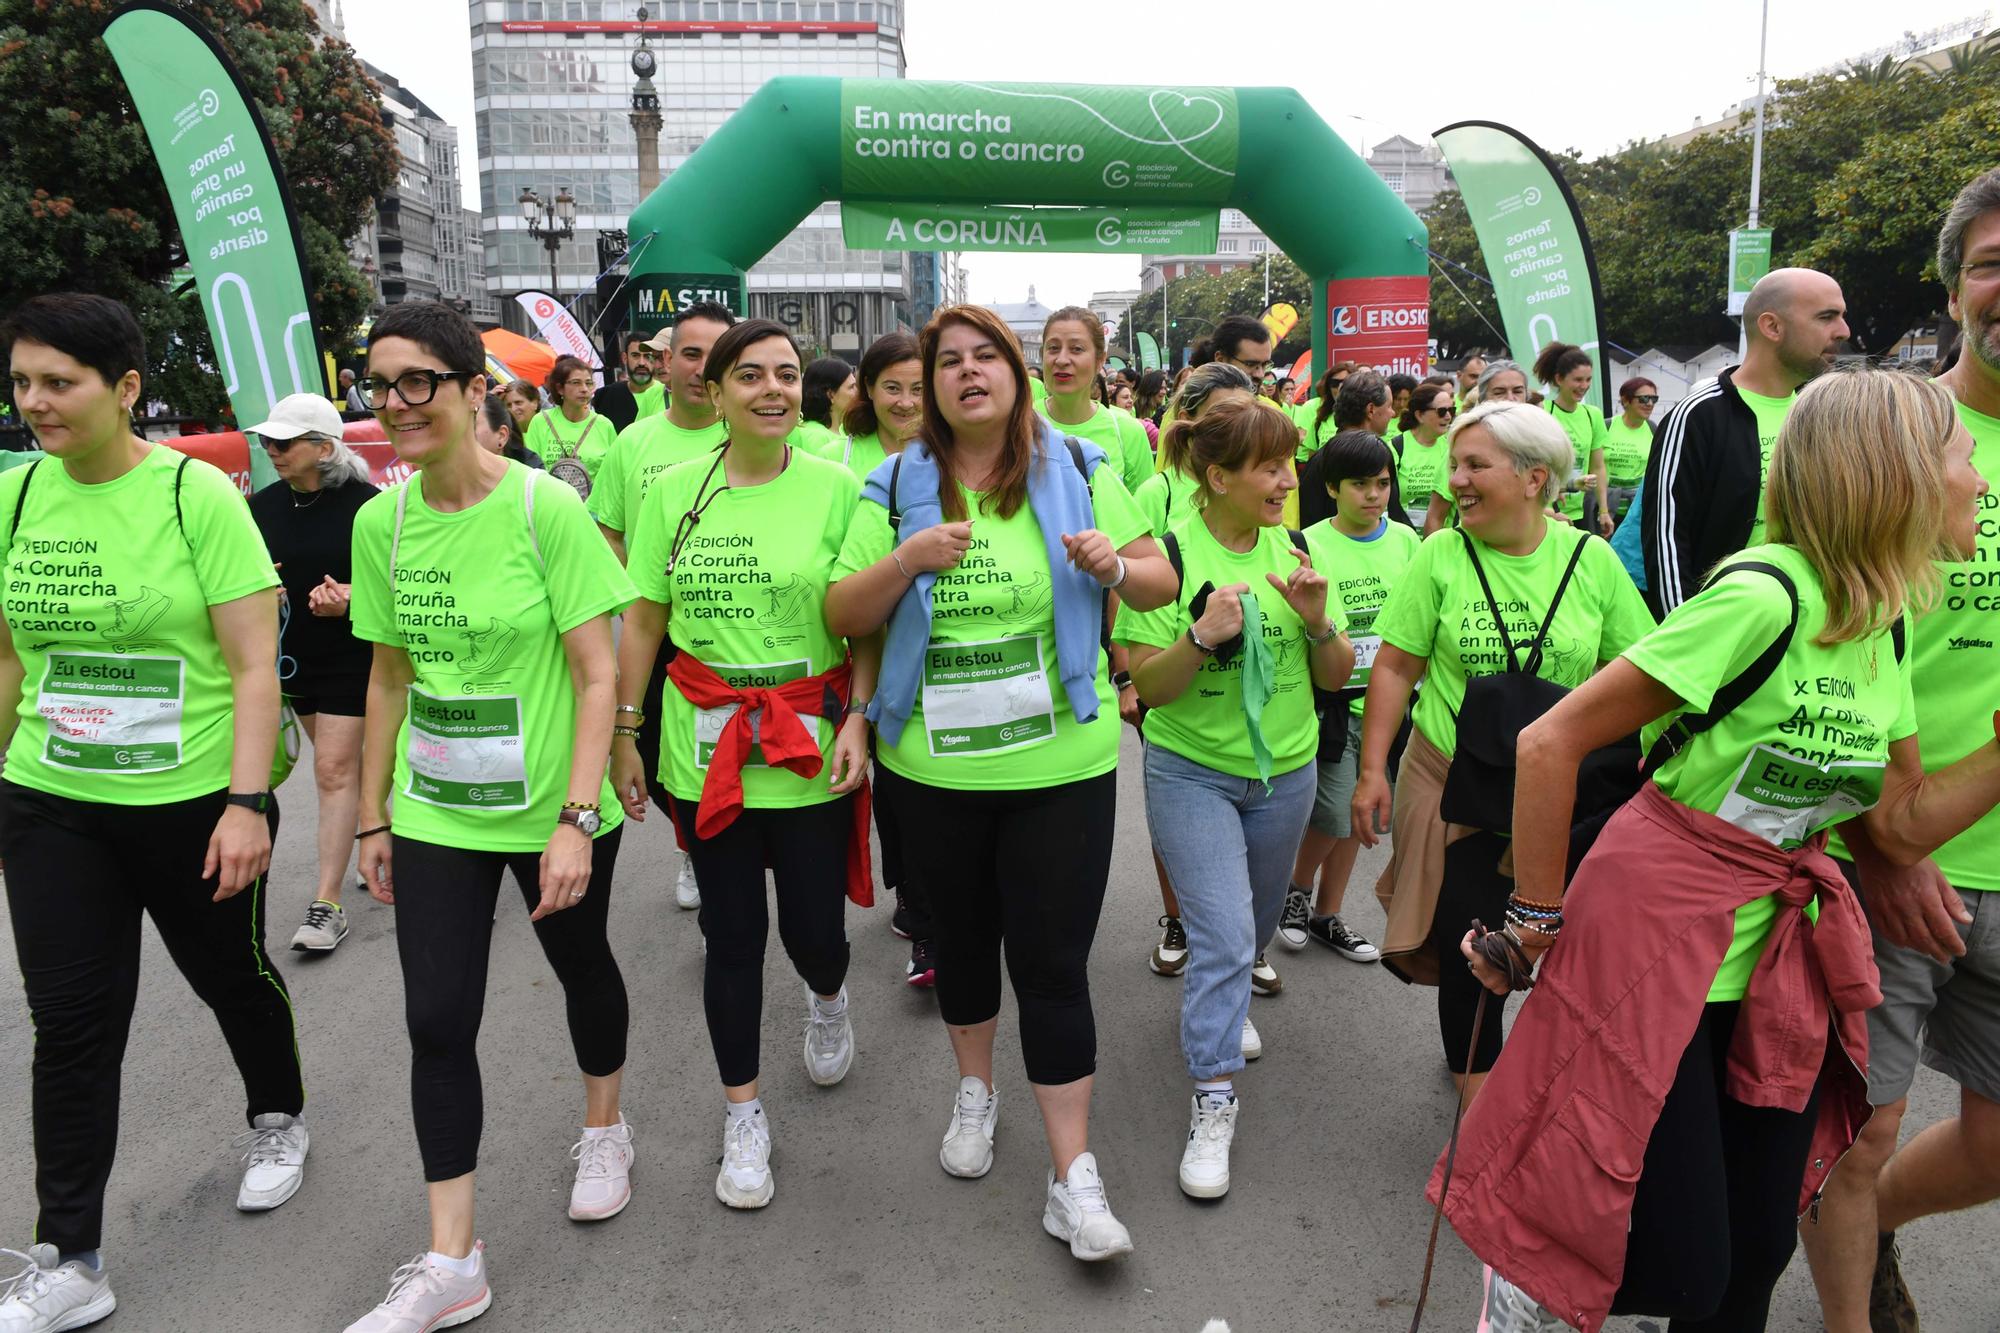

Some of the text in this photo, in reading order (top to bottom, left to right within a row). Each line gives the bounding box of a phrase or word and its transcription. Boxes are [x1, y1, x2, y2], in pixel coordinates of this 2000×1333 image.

[855, 106, 1011, 133] En marcha
[855, 134, 1085, 162] contra o cancro
[885, 214, 1048, 246] A CORUÑA
[33, 537, 98, 554] EDICIÓN
[694, 533, 753, 549] EDICIÓN
[691, 553, 759, 567] Coruña
[960, 555, 996, 570] uña
[13, 560, 103, 577] A Coruña
[676, 569, 772, 585] en marcha
[934, 569, 1013, 586] marcha
[1338, 575, 1382, 592] EDICIÓN
[1949, 571, 2000, 588] con
[10, 580, 117, 597] en marcha
[680, 587, 733, 602] contra
[932, 588, 969, 604] ntra
[1343, 589, 1388, 605] Coruña
[1947, 595, 1966, 611] o
[6, 598, 70, 615] contra
[684, 606, 755, 619] o cancro
[932, 605, 994, 620] ancro
[8, 618, 97, 632] o cancro
[1460, 617, 1540, 633] A Couña
[1459, 636, 1480, 648] en
[1948, 636, 1994, 650] Vegalsa
[932, 650, 1004, 669] Eu estou
[1207, 658, 1244, 673] canc
[1460, 651, 1506, 665] contr
[54, 661, 136, 680] Eu estou
[942, 671, 970, 680] marcha
[971, 668, 997, 678] contra
[1005, 661, 1031, 673] cancro
[63, 681, 94, 690] marcha
[95, 683, 126, 692] contra
[728, 674, 777, 689] estou
[1793, 679, 1809, 696] X
[427, 705, 476, 721] estou
[477, 724, 509, 732] cancro
[1777, 719, 1816, 739] en
[940, 734, 971, 746] Vegalsa
[1761, 761, 1799, 789] Eu
[1753, 785, 1770, 798] en
